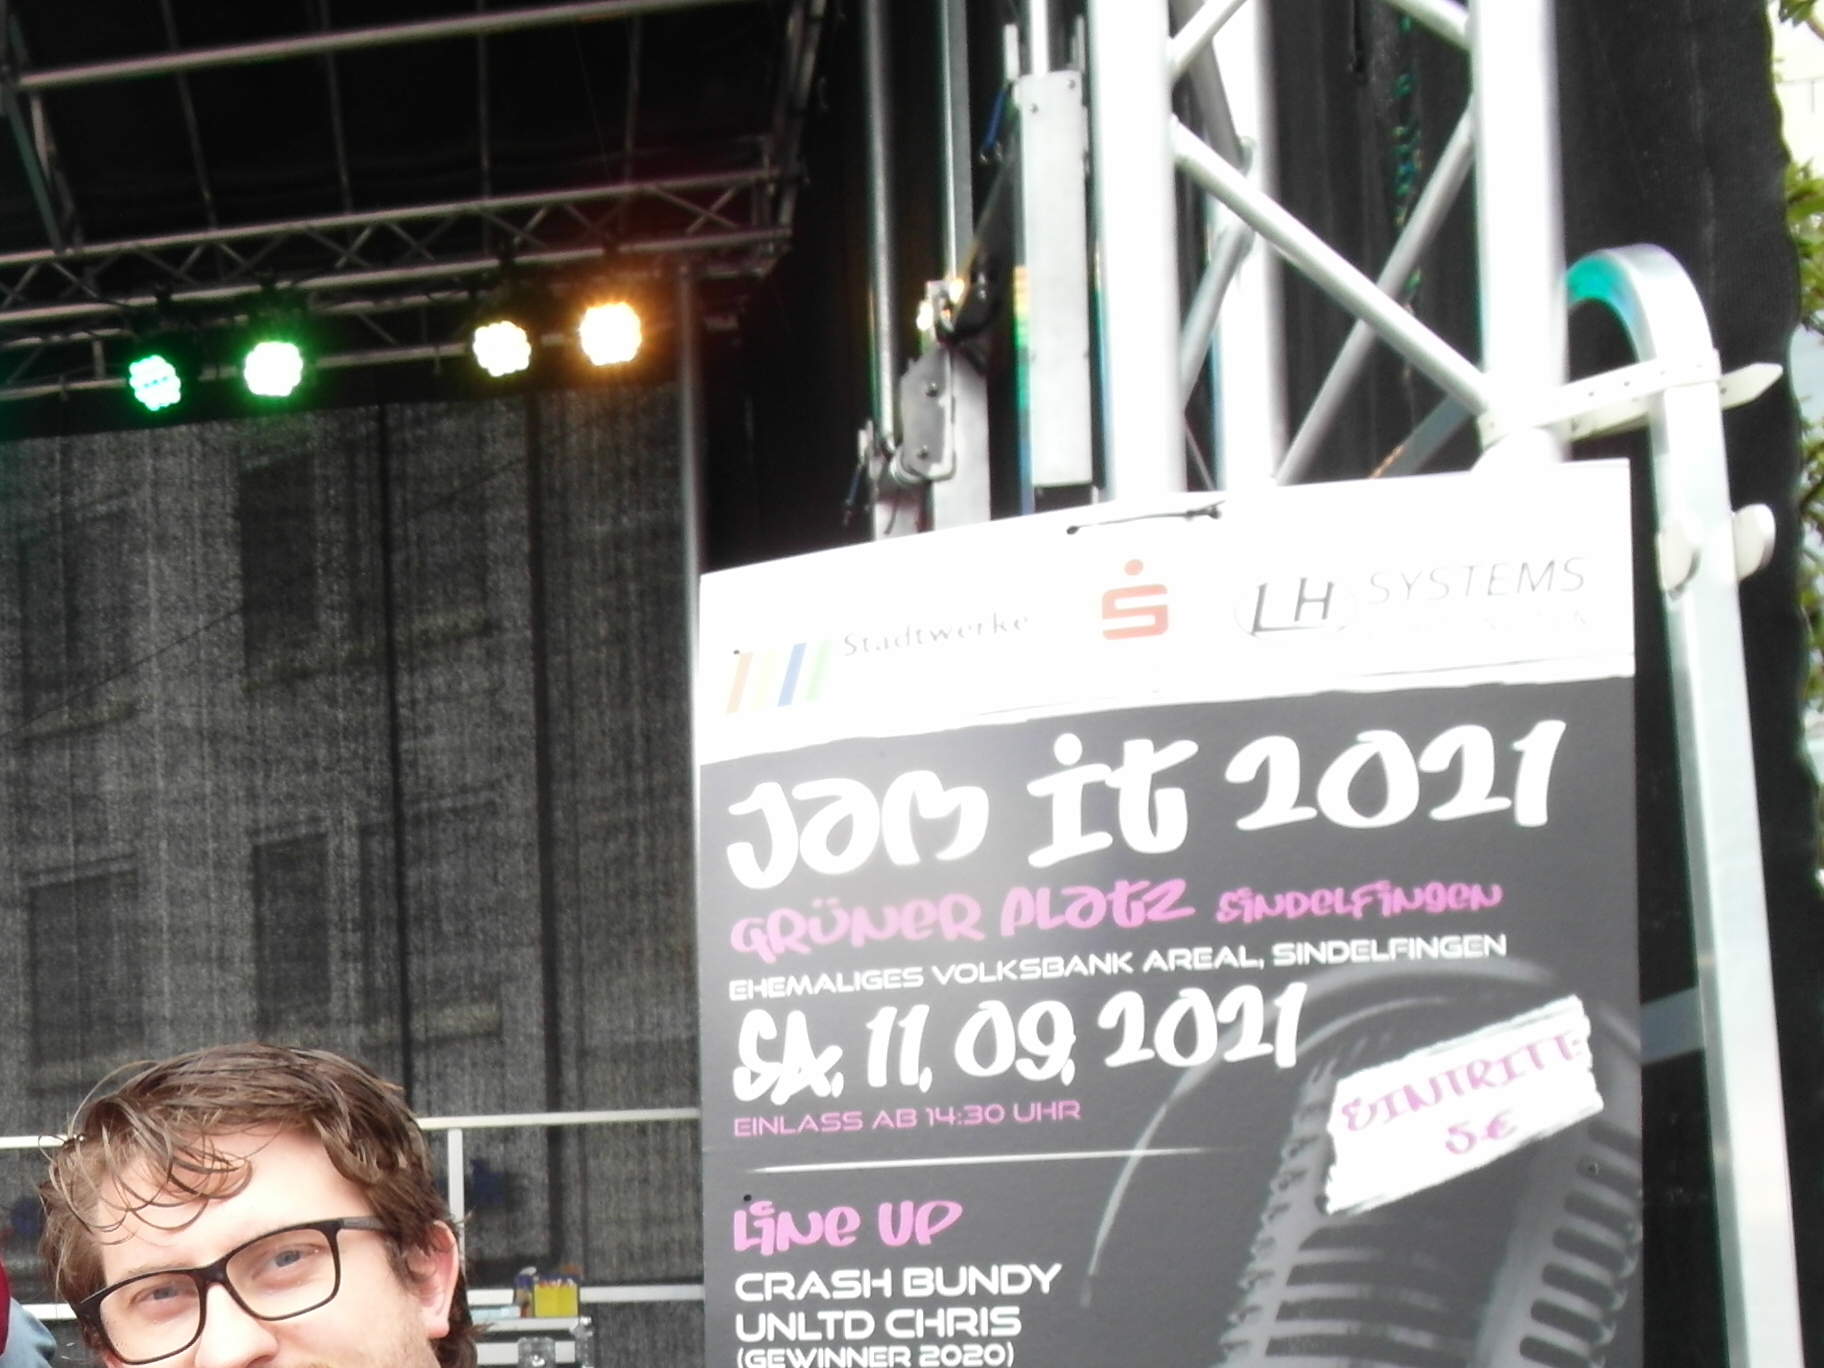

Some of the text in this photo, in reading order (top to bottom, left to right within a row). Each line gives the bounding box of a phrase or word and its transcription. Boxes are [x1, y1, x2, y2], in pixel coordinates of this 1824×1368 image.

[1368, 557, 1585, 605] SYSTEMS
[1225, 720, 1567, 831] 2021
[729, 966, 924, 1001] EHEMALIGES
[931, 952, 1134, 985] VOLKSBANK
[1272, 934, 1506, 967] SINDELFINGEN
[1097, 981, 1307, 1069] 2021
[734, 1100, 1082, 1137] EINLASS AB 14:30 UHR
[735, 1263, 1063, 1302] CRASH BUNDY
[735, 1306, 1022, 1342] UNLTD CHRIS
[919, 1342, 1014, 1368] 2020)
